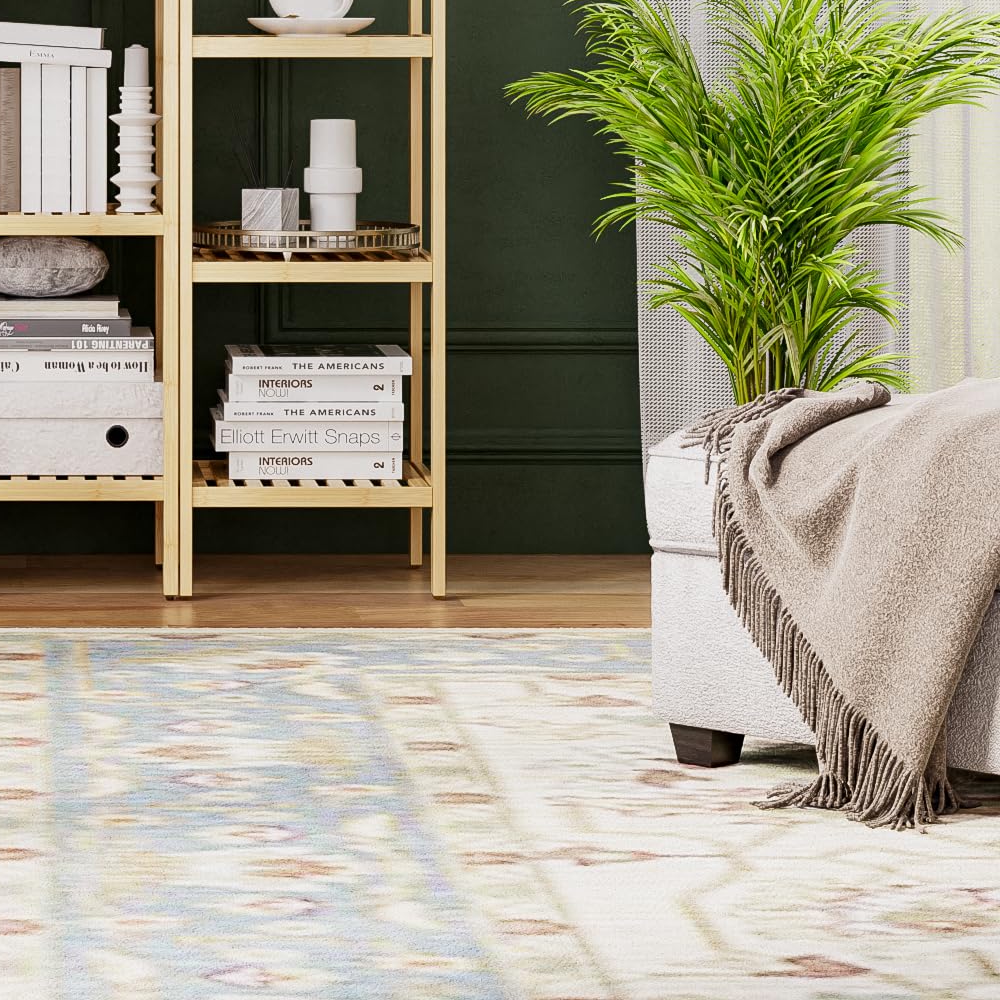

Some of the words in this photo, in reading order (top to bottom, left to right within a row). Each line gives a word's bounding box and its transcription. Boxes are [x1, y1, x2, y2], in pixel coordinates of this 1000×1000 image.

[71, 340, 89, 350] 101
[91, 340, 149, 350] PARENTING
[44, 361, 86, 373] Woman
[88, 361, 95, 370] a
[96, 361, 109, 373] be
[110, 361, 121, 371] to
[124, 361, 148, 373] How
[292, 362, 314, 370] THE
[318, 362, 385, 370] AMERICANS
[258, 379, 313, 389] INTERIORS
[258, 388, 289, 398] NOW!
[220, 428, 265, 444] Elliott
[271, 428, 319, 444] Erwitt
[324, 428, 381, 448] Snaps
[258, 456, 313, 466] INTERIORS
[373, 461, 385, 469] 2
[258, 466, 289, 476] NOW!
